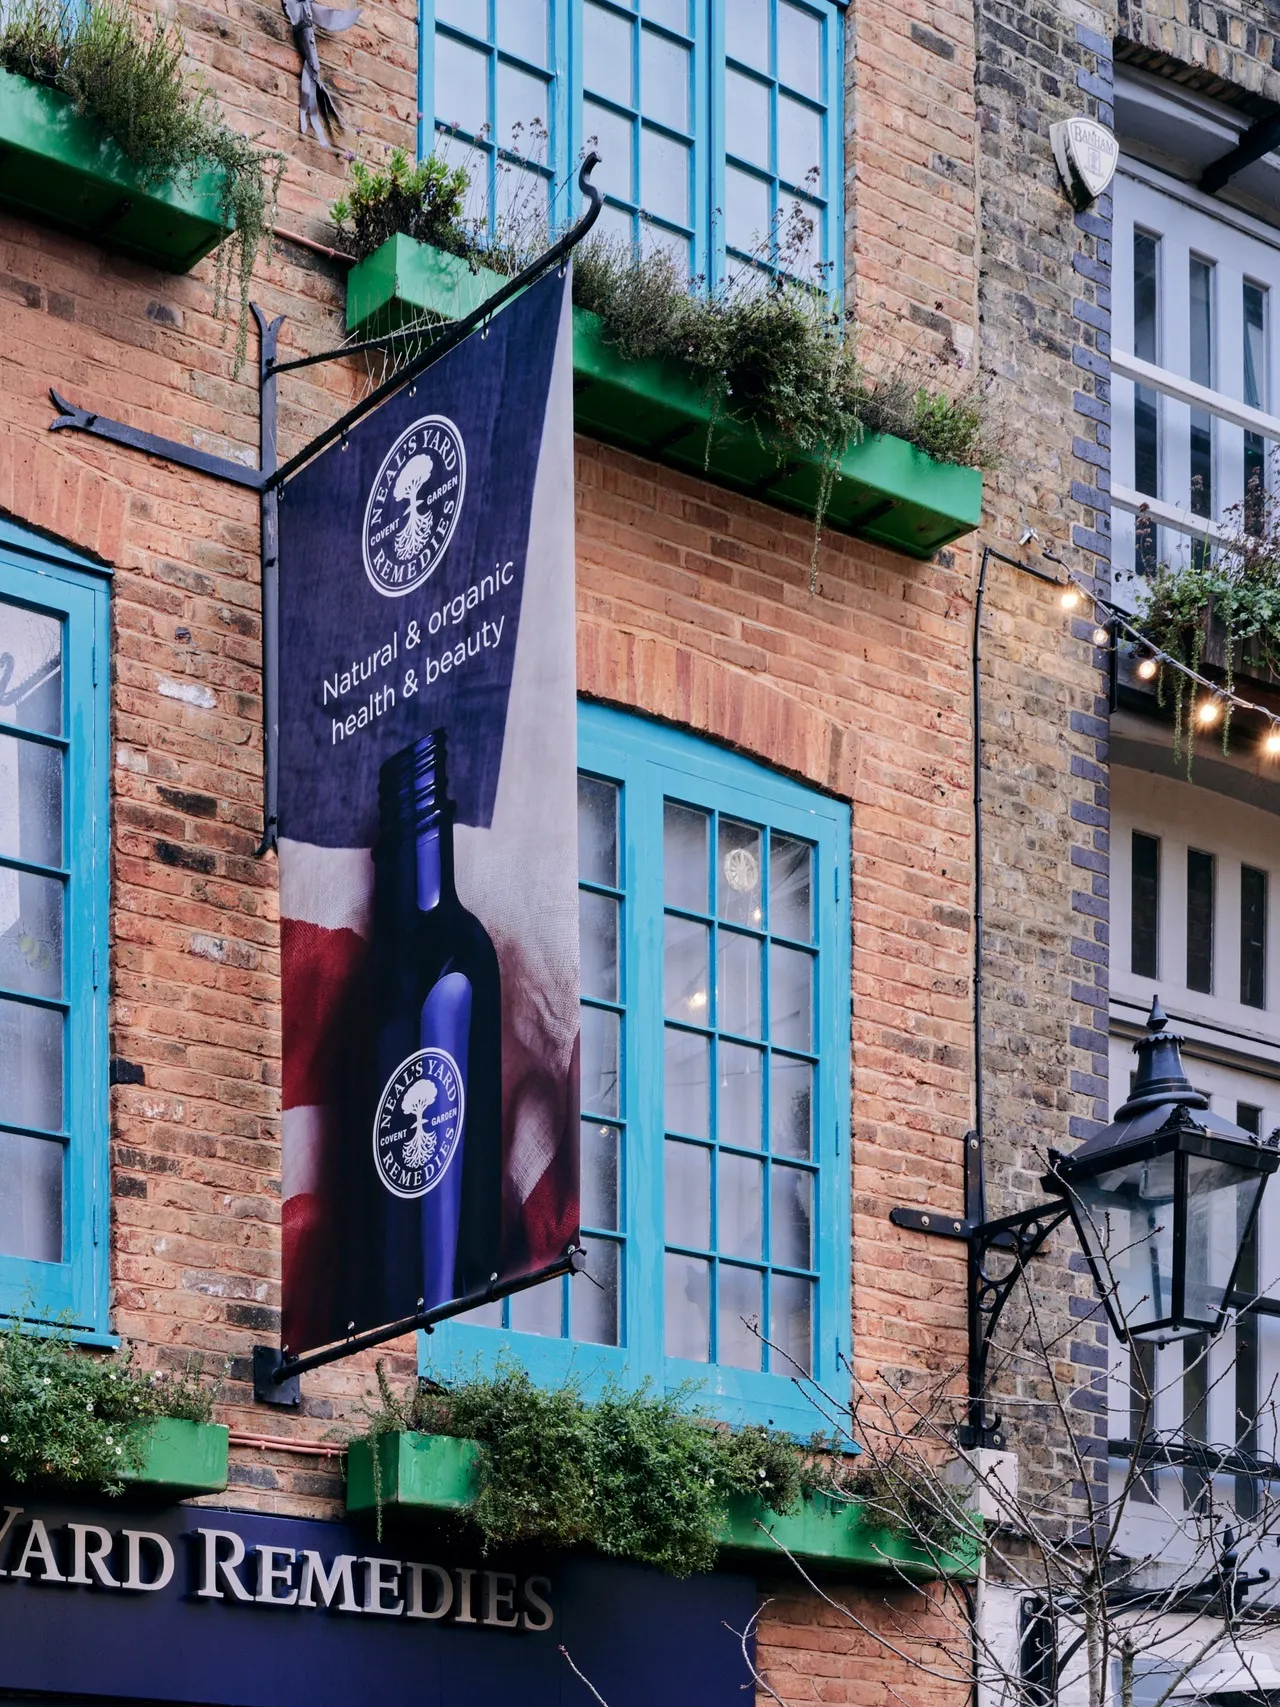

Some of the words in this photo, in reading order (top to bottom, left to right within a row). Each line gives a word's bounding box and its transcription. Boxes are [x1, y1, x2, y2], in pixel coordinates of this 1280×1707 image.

[1074, 125, 1114, 155] BANHAM
[370, 434, 417, 526] NEAL'S
[422, 429, 457, 471] YARD
[370, 518, 400, 547] COVENT
[426, 475, 458, 505] GARDEN
[373, 499, 456, 583] REMEDIES
[322, 632, 399, 705] Natural
[405, 619, 422, 650] &
[428, 561, 514, 635] organic
[332, 687, 396, 745] health
[402, 668, 419, 698] &
[426, 615, 506, 685] beauty
[380, 1061, 423, 1129] NEAL'S
[428, 1059, 457, 1101] YARD
[380, 1129, 407, 1147] COVENT
[431, 1107, 457, 1127] GARDEN
[383, 1127, 455, 1187] REMEDIES
[196, 1527, 554, 1632] REMEDIES
